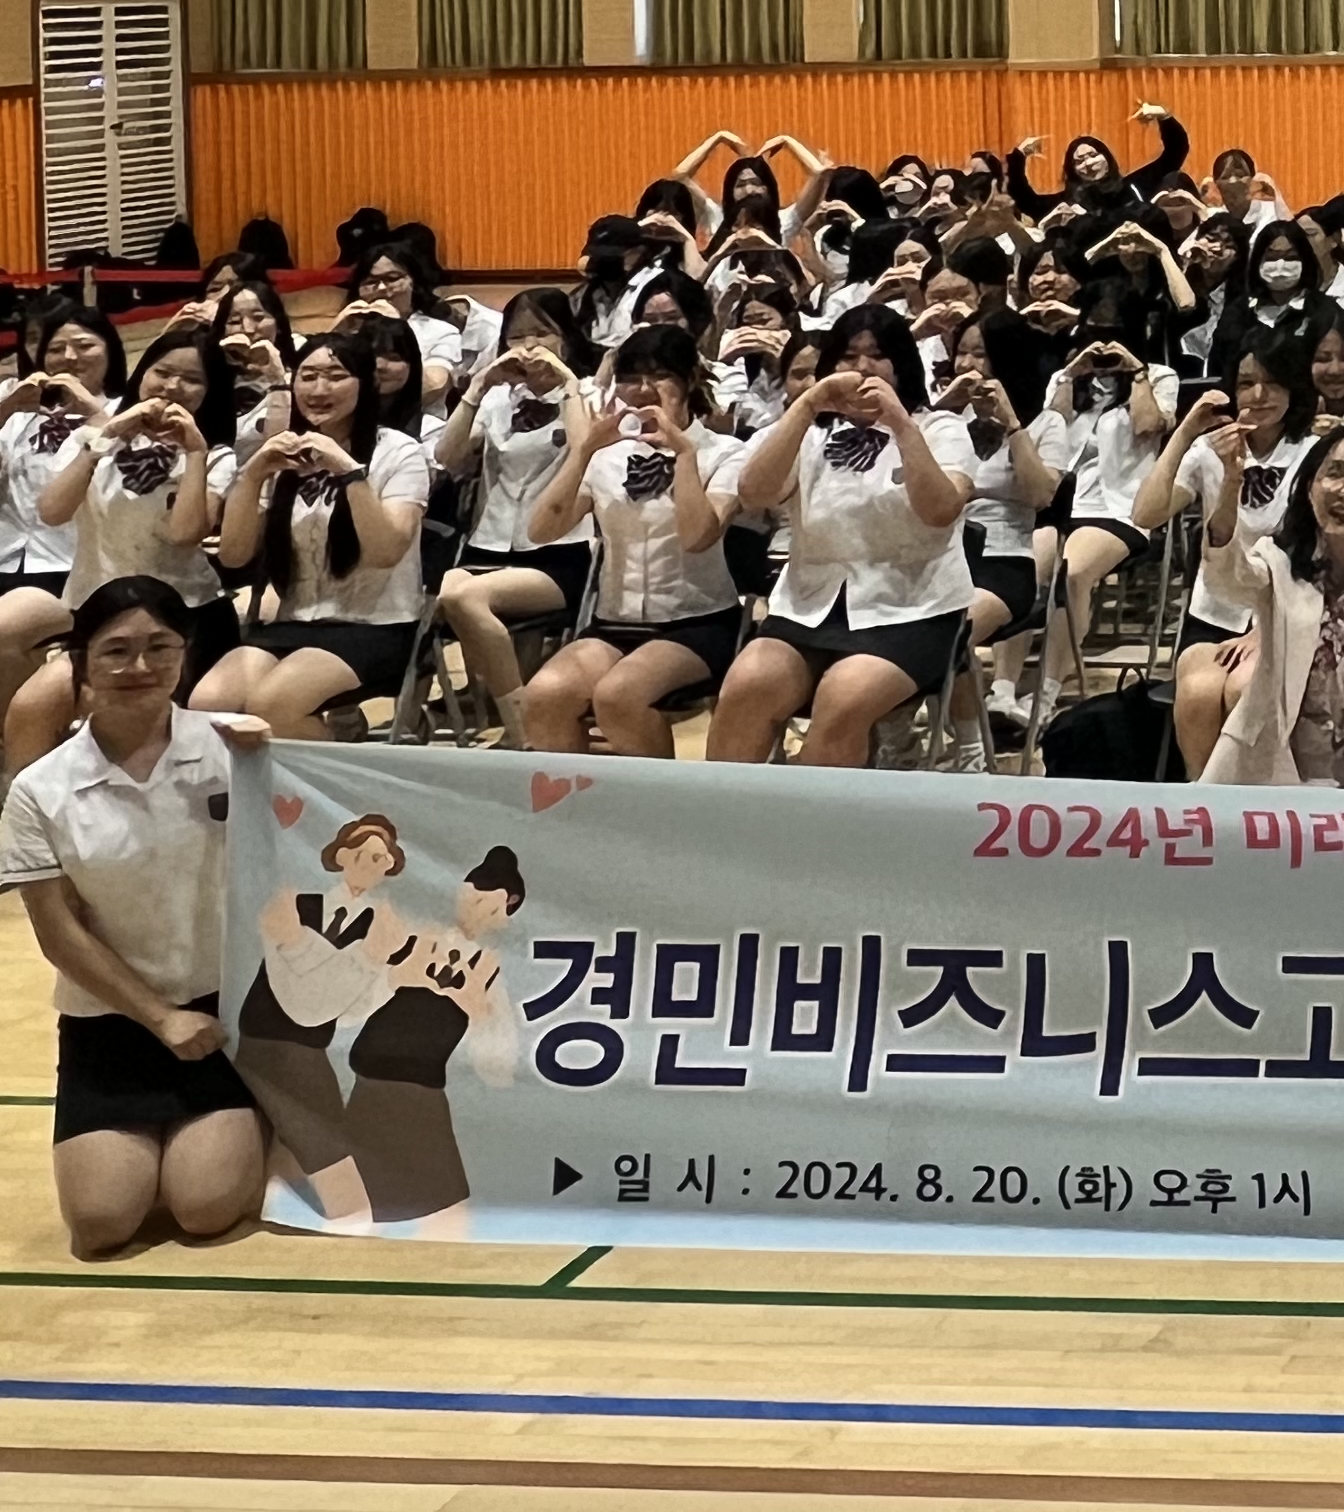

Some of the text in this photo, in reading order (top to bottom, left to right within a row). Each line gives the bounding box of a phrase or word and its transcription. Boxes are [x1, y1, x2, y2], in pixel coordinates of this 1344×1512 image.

[976, 803, 1214, 866] 2024년
[614, 1153, 651, 1203] 일
[676, 1154, 716, 1205] 시
[774, 1160, 899, 1203] 2024.
[915, 1163, 954, 1204] 8.
[971, 1165, 1041, 1206] 20.
[1058, 1164, 1133, 1213] (화)
[1148, 1168, 1237, 1215] 오후
[1251, 1170, 1311, 1217] 1시
